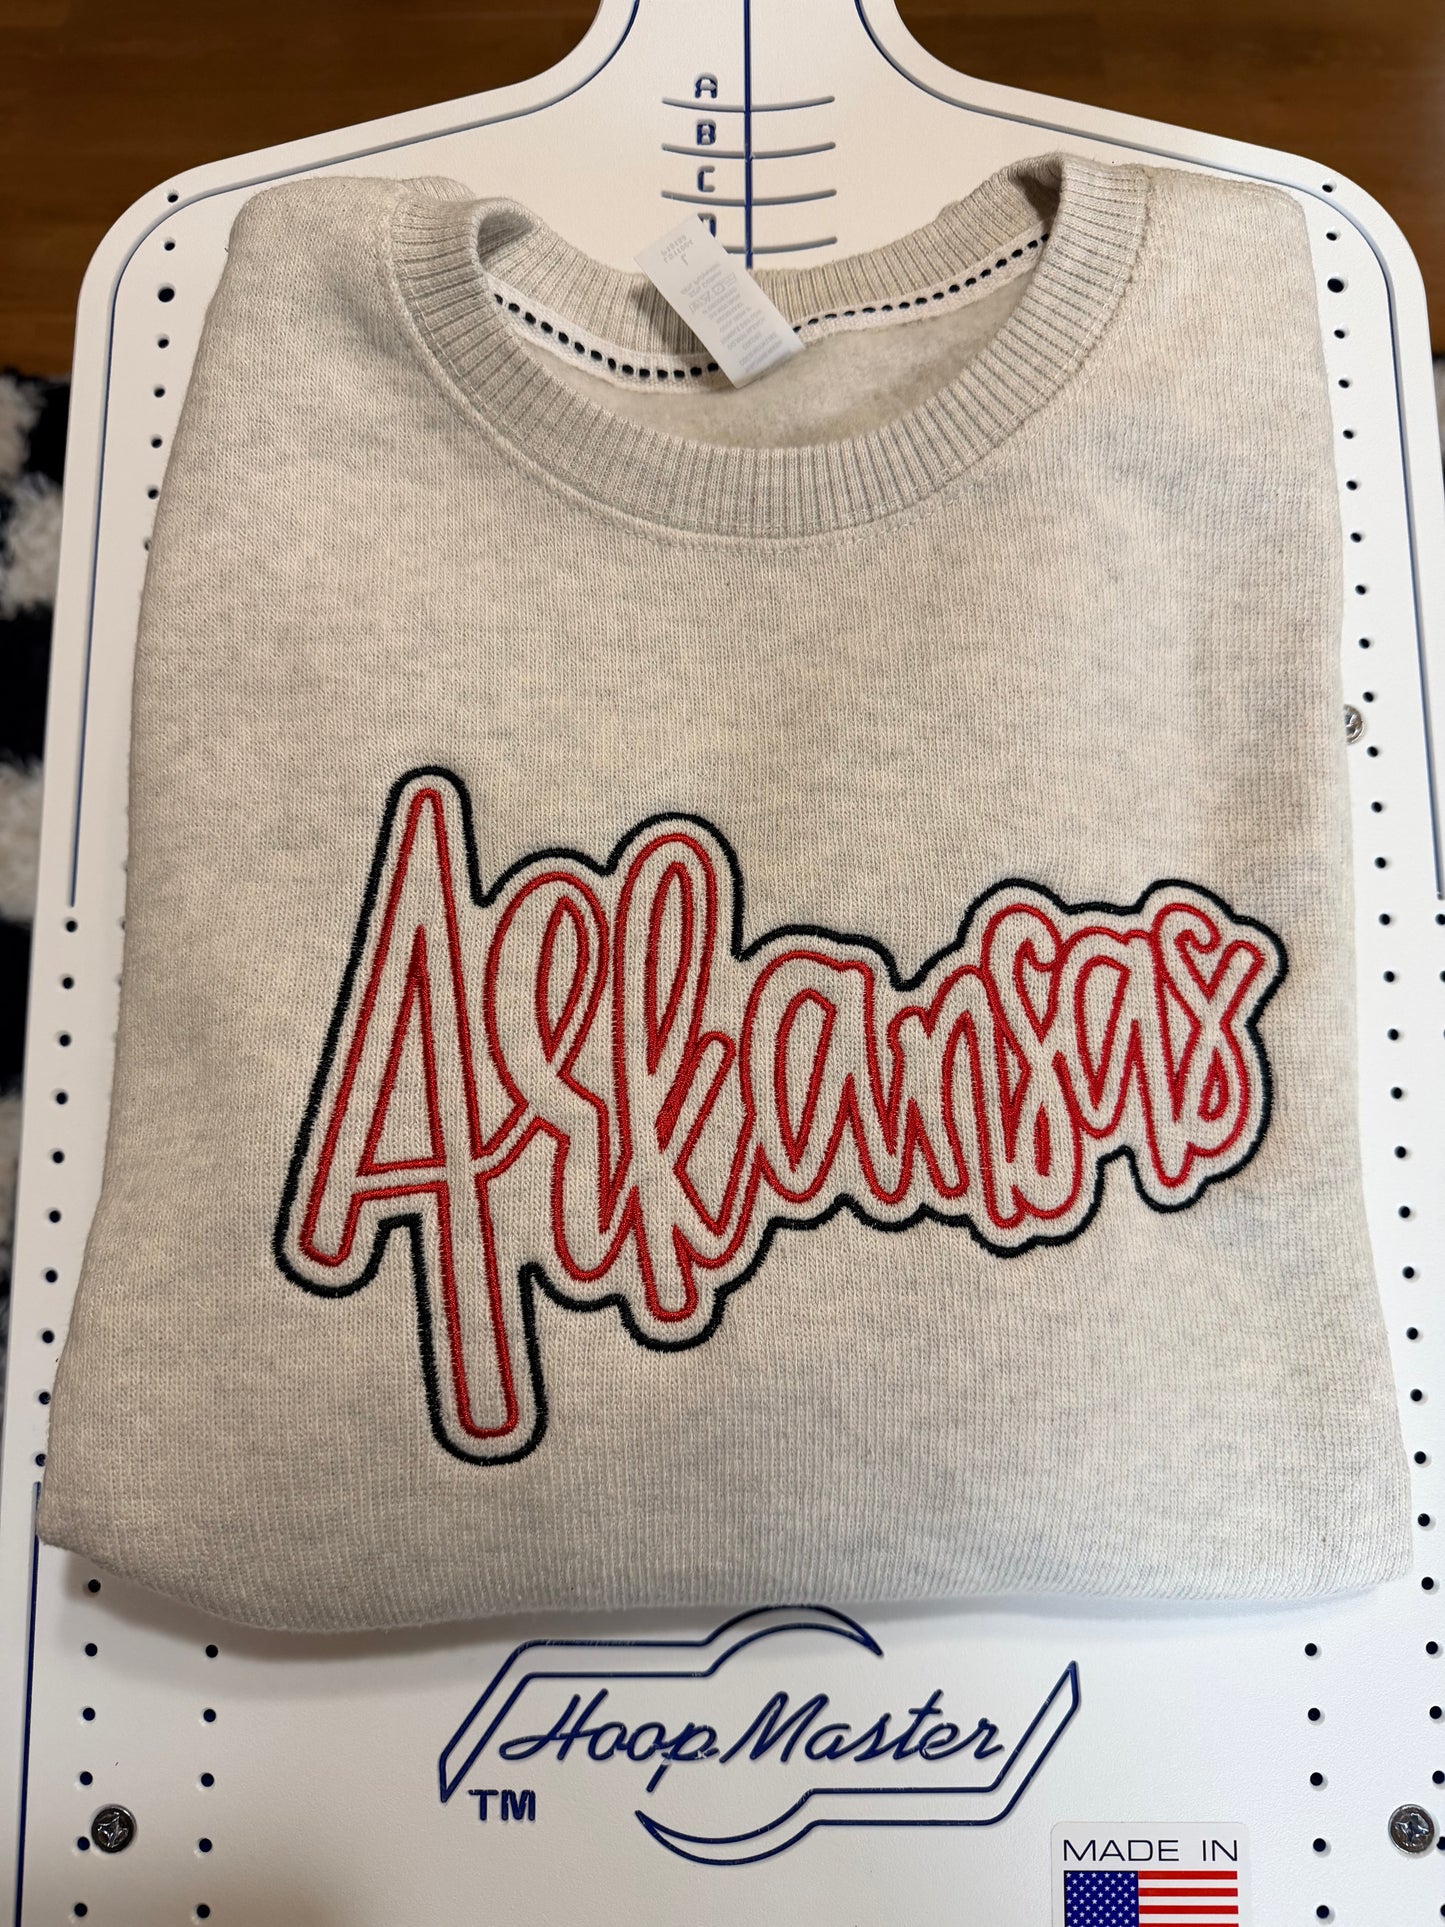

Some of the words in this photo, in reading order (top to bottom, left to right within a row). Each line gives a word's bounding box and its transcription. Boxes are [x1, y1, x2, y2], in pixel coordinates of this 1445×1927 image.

[694, 74, 718, 99] A
[696, 119, 716, 145] B
[697, 165, 715, 192] C
[273, 765, 1289, 1466] Arkansas
[468, 1789, 536, 1821] TM
[1063, 1839, 1179, 1862] MADE
[1202, 1839, 1238, 1862] IN
